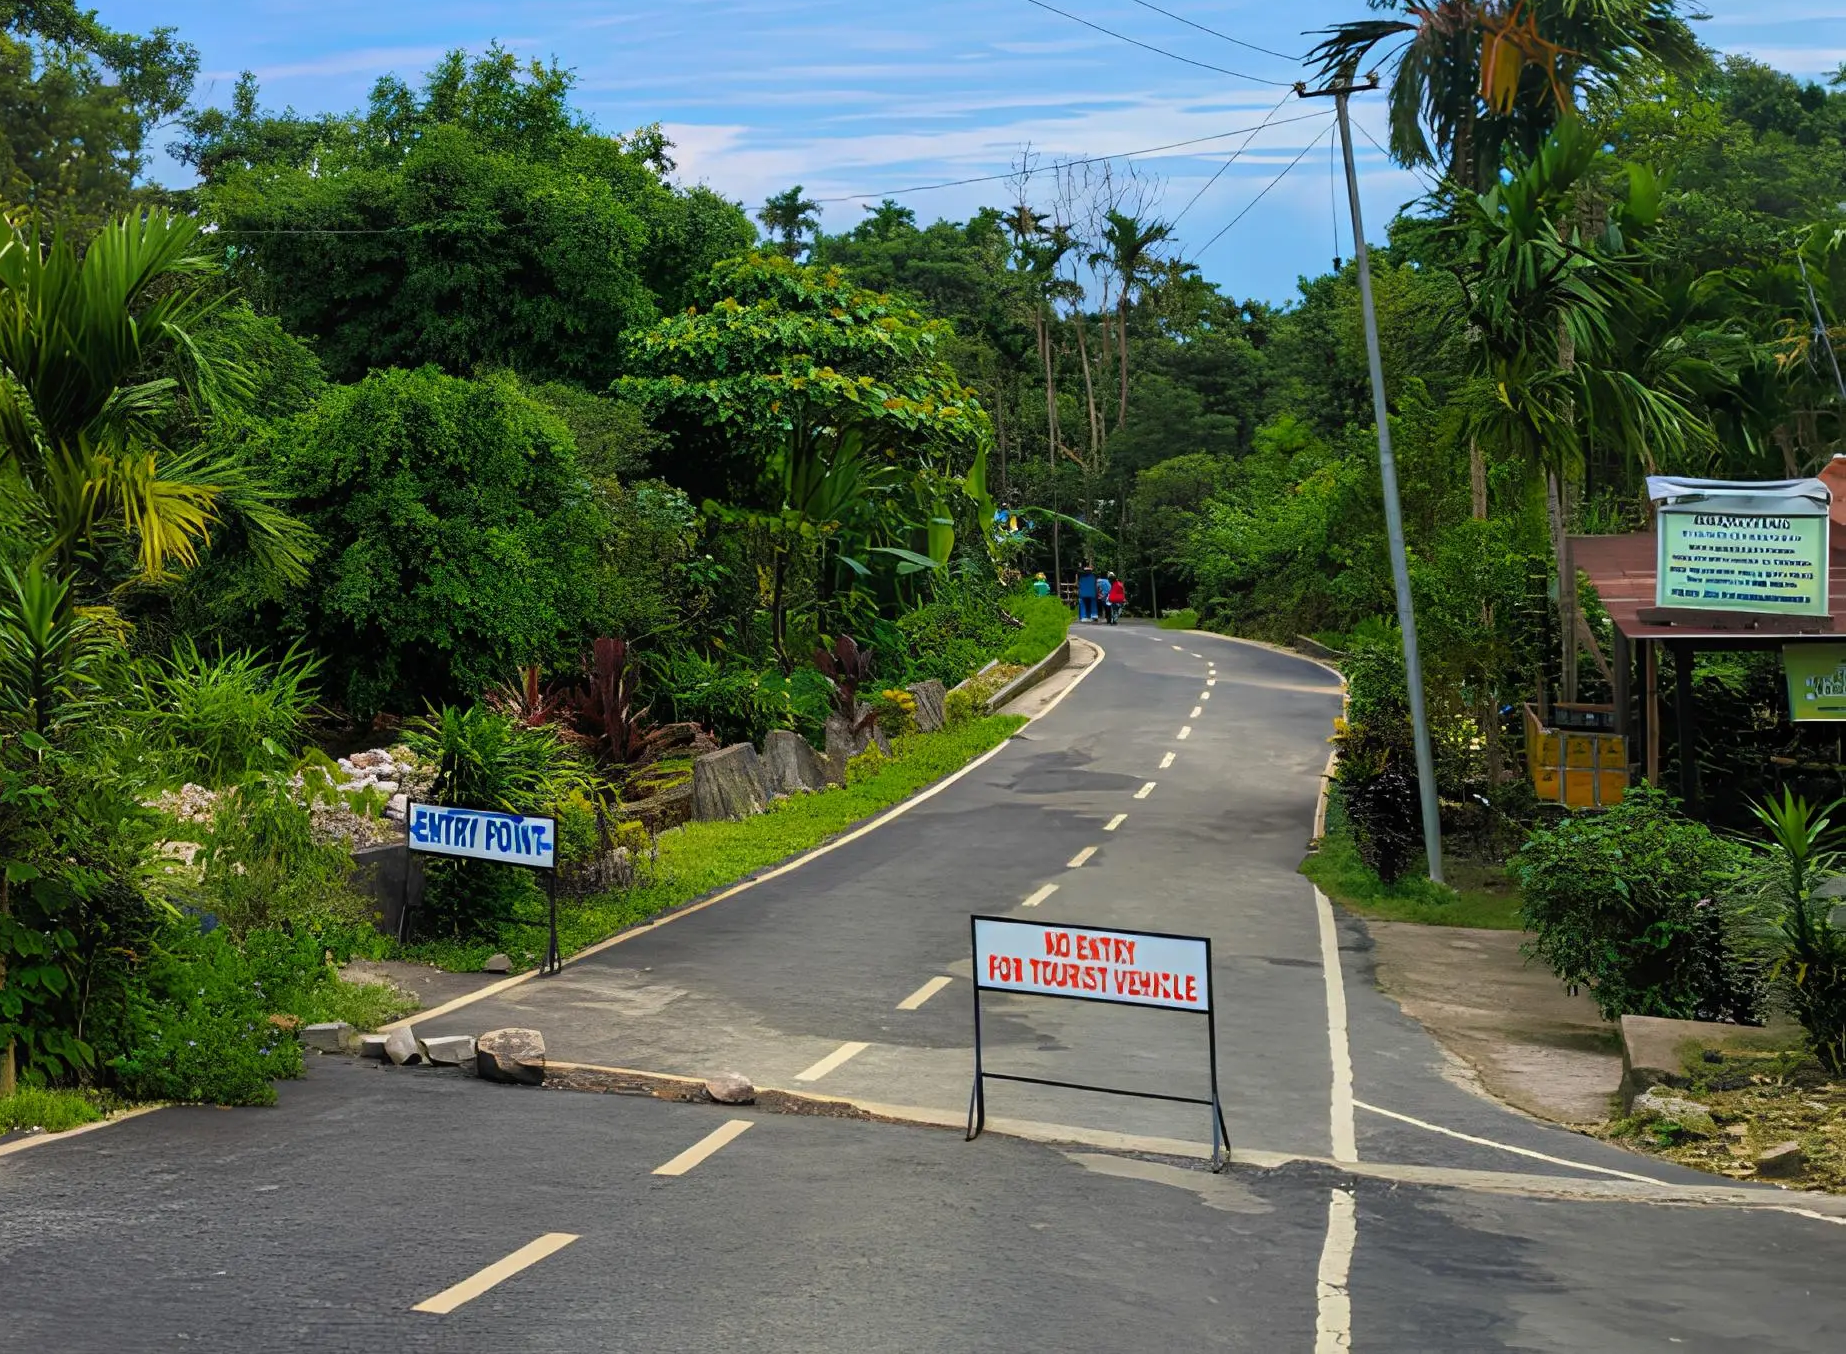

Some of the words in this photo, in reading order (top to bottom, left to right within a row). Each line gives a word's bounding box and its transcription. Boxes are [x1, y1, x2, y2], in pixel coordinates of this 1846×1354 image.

[485, 818, 552, 856] POINT
[1044, 931, 1071, 958] NO
[1076, 934, 1136, 965] ENTRY
[988, 954, 1023, 983] FOR
